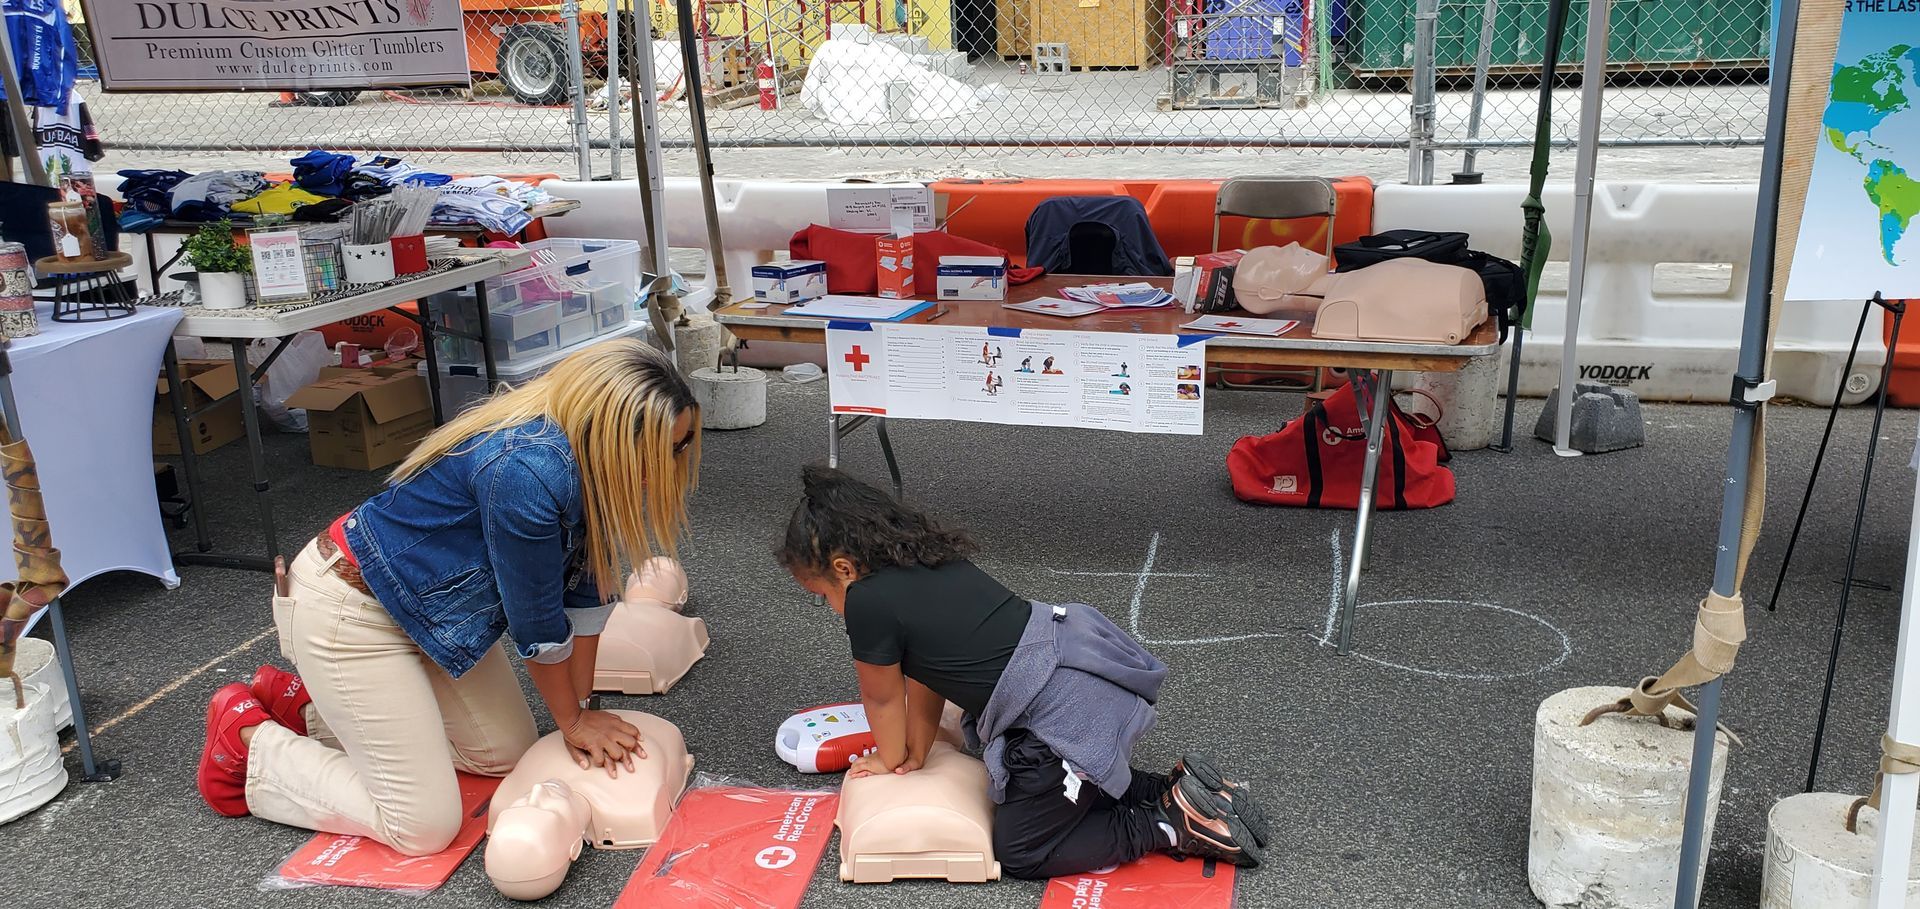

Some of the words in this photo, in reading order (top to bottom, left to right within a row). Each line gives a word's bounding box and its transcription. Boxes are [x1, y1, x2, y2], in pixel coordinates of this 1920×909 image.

[1856, 0, 1885, 12] THE
[136, 2, 268, 33] DULCE
[267, 0, 401, 32] PRINTS
[146, 42, 232, 60] Premium
[240, 41, 307, 59] Custom
[312, 40, 365, 58] Glitter
[369, 37, 444, 55] Tumblers
[216, 60, 393, 76] www.dulceprints.com
[339, 315, 385, 327] ODOCK
[1579, 365, 1653, 380] YODOCK
[772, 797, 804, 841] American
[786, 823, 805, 842] Red
[796, 797, 818, 823] Cross
[1075, 878, 1093, 897] Red
